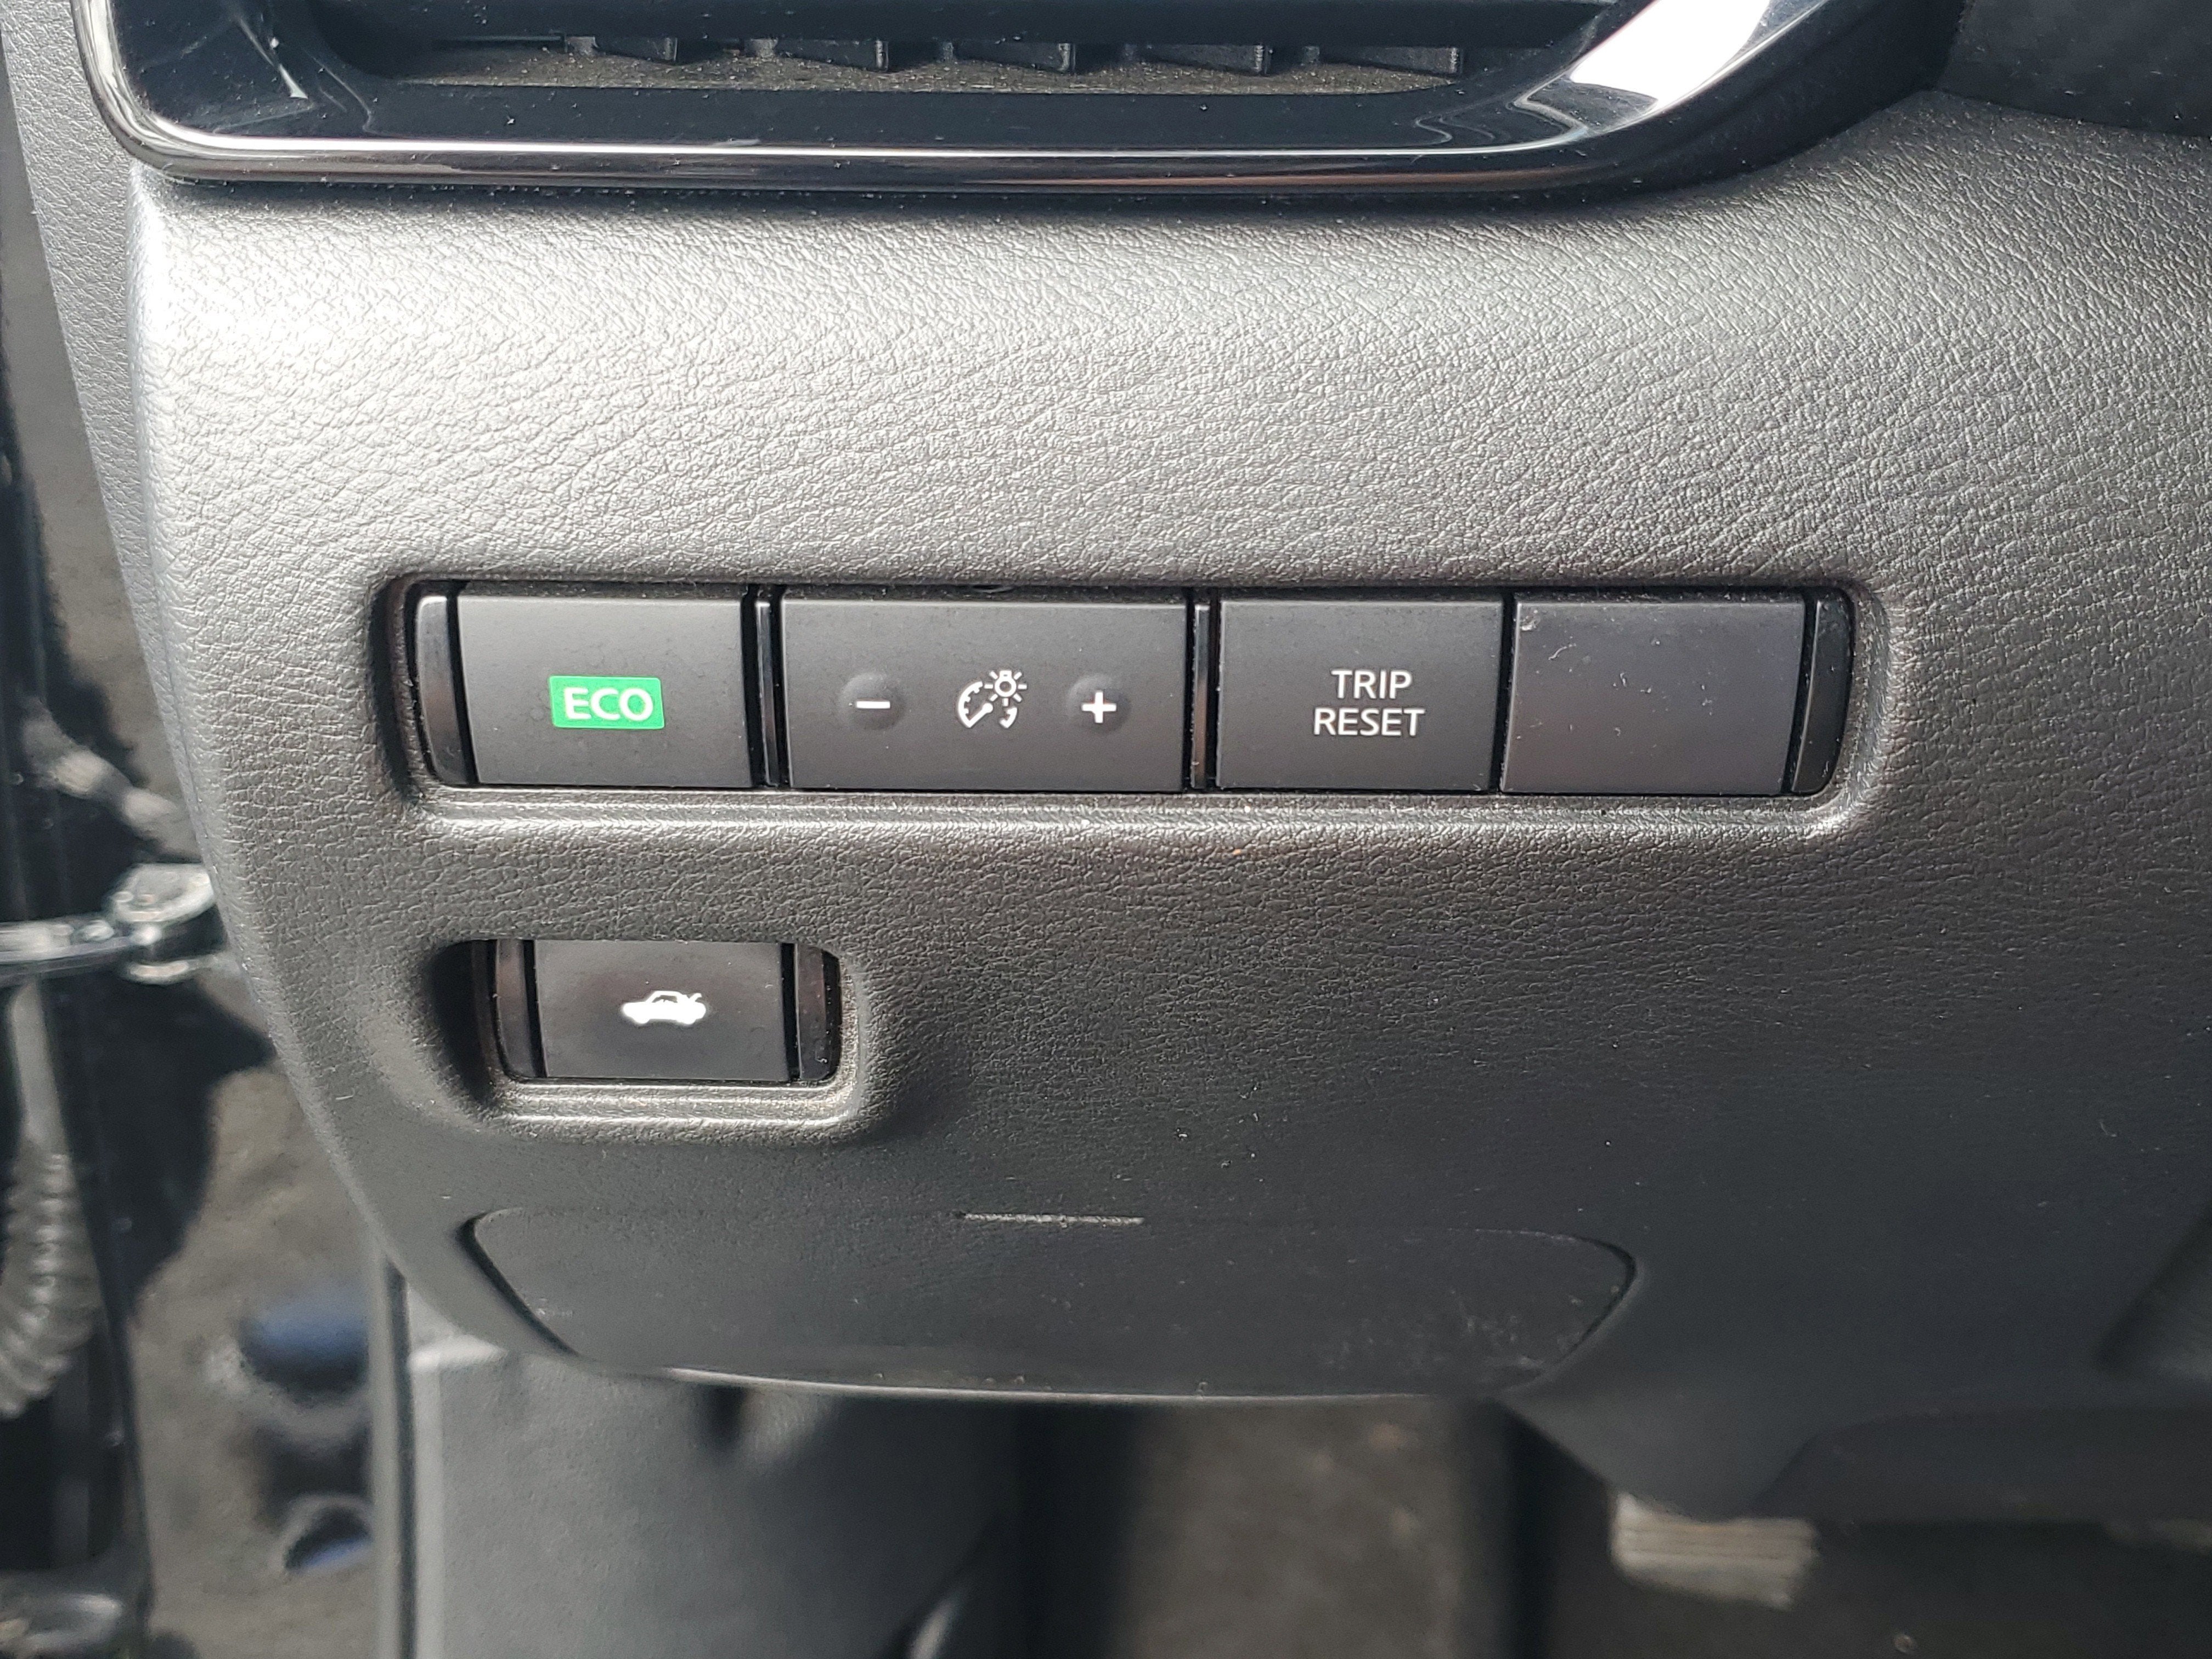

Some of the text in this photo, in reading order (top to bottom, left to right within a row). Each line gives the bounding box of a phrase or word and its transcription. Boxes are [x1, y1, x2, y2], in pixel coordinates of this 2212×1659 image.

[1330, 668, 1413, 699] TRIP
[563, 686, 654, 721] ECO
[1313, 707, 1426, 736] RESET
